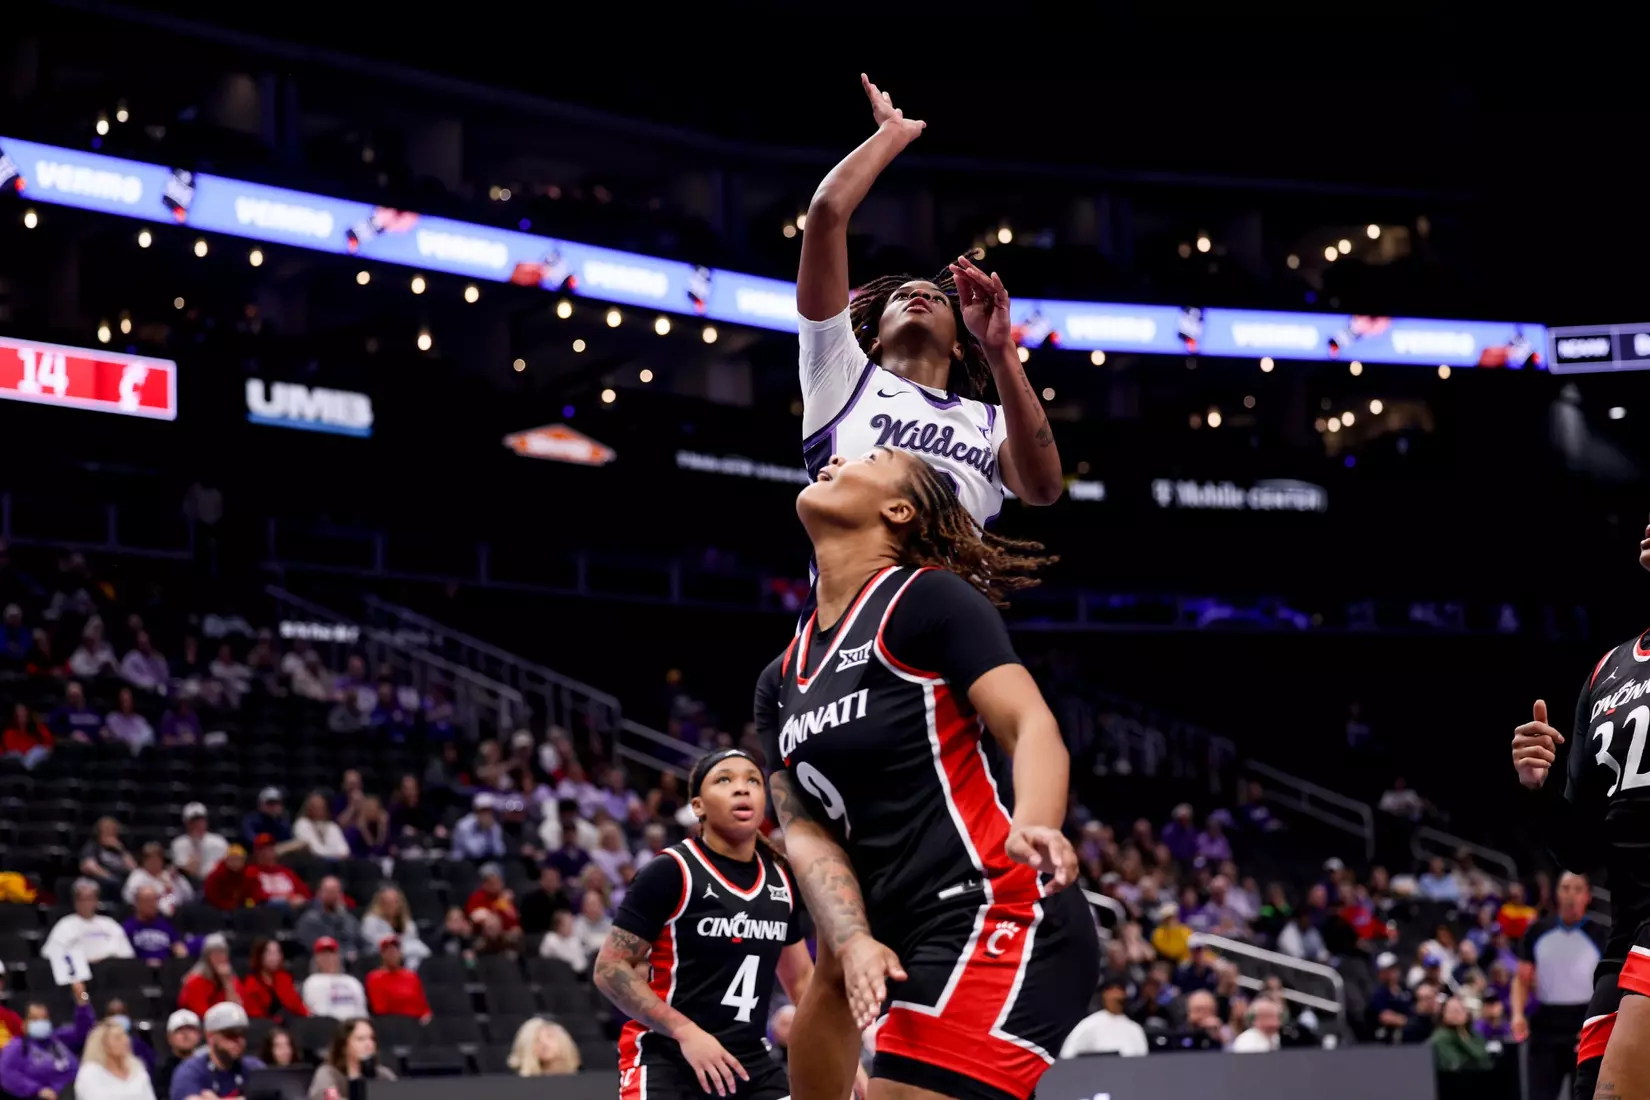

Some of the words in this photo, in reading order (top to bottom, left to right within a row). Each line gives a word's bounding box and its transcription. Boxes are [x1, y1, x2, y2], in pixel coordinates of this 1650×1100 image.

[17, 348, 69, 398] 14
[245, 377, 374, 429] UMB
[870, 413, 995, 483] Wildcats
[1592, 705, 1650, 797] 32
[720, 954, 760, 1023] 4
